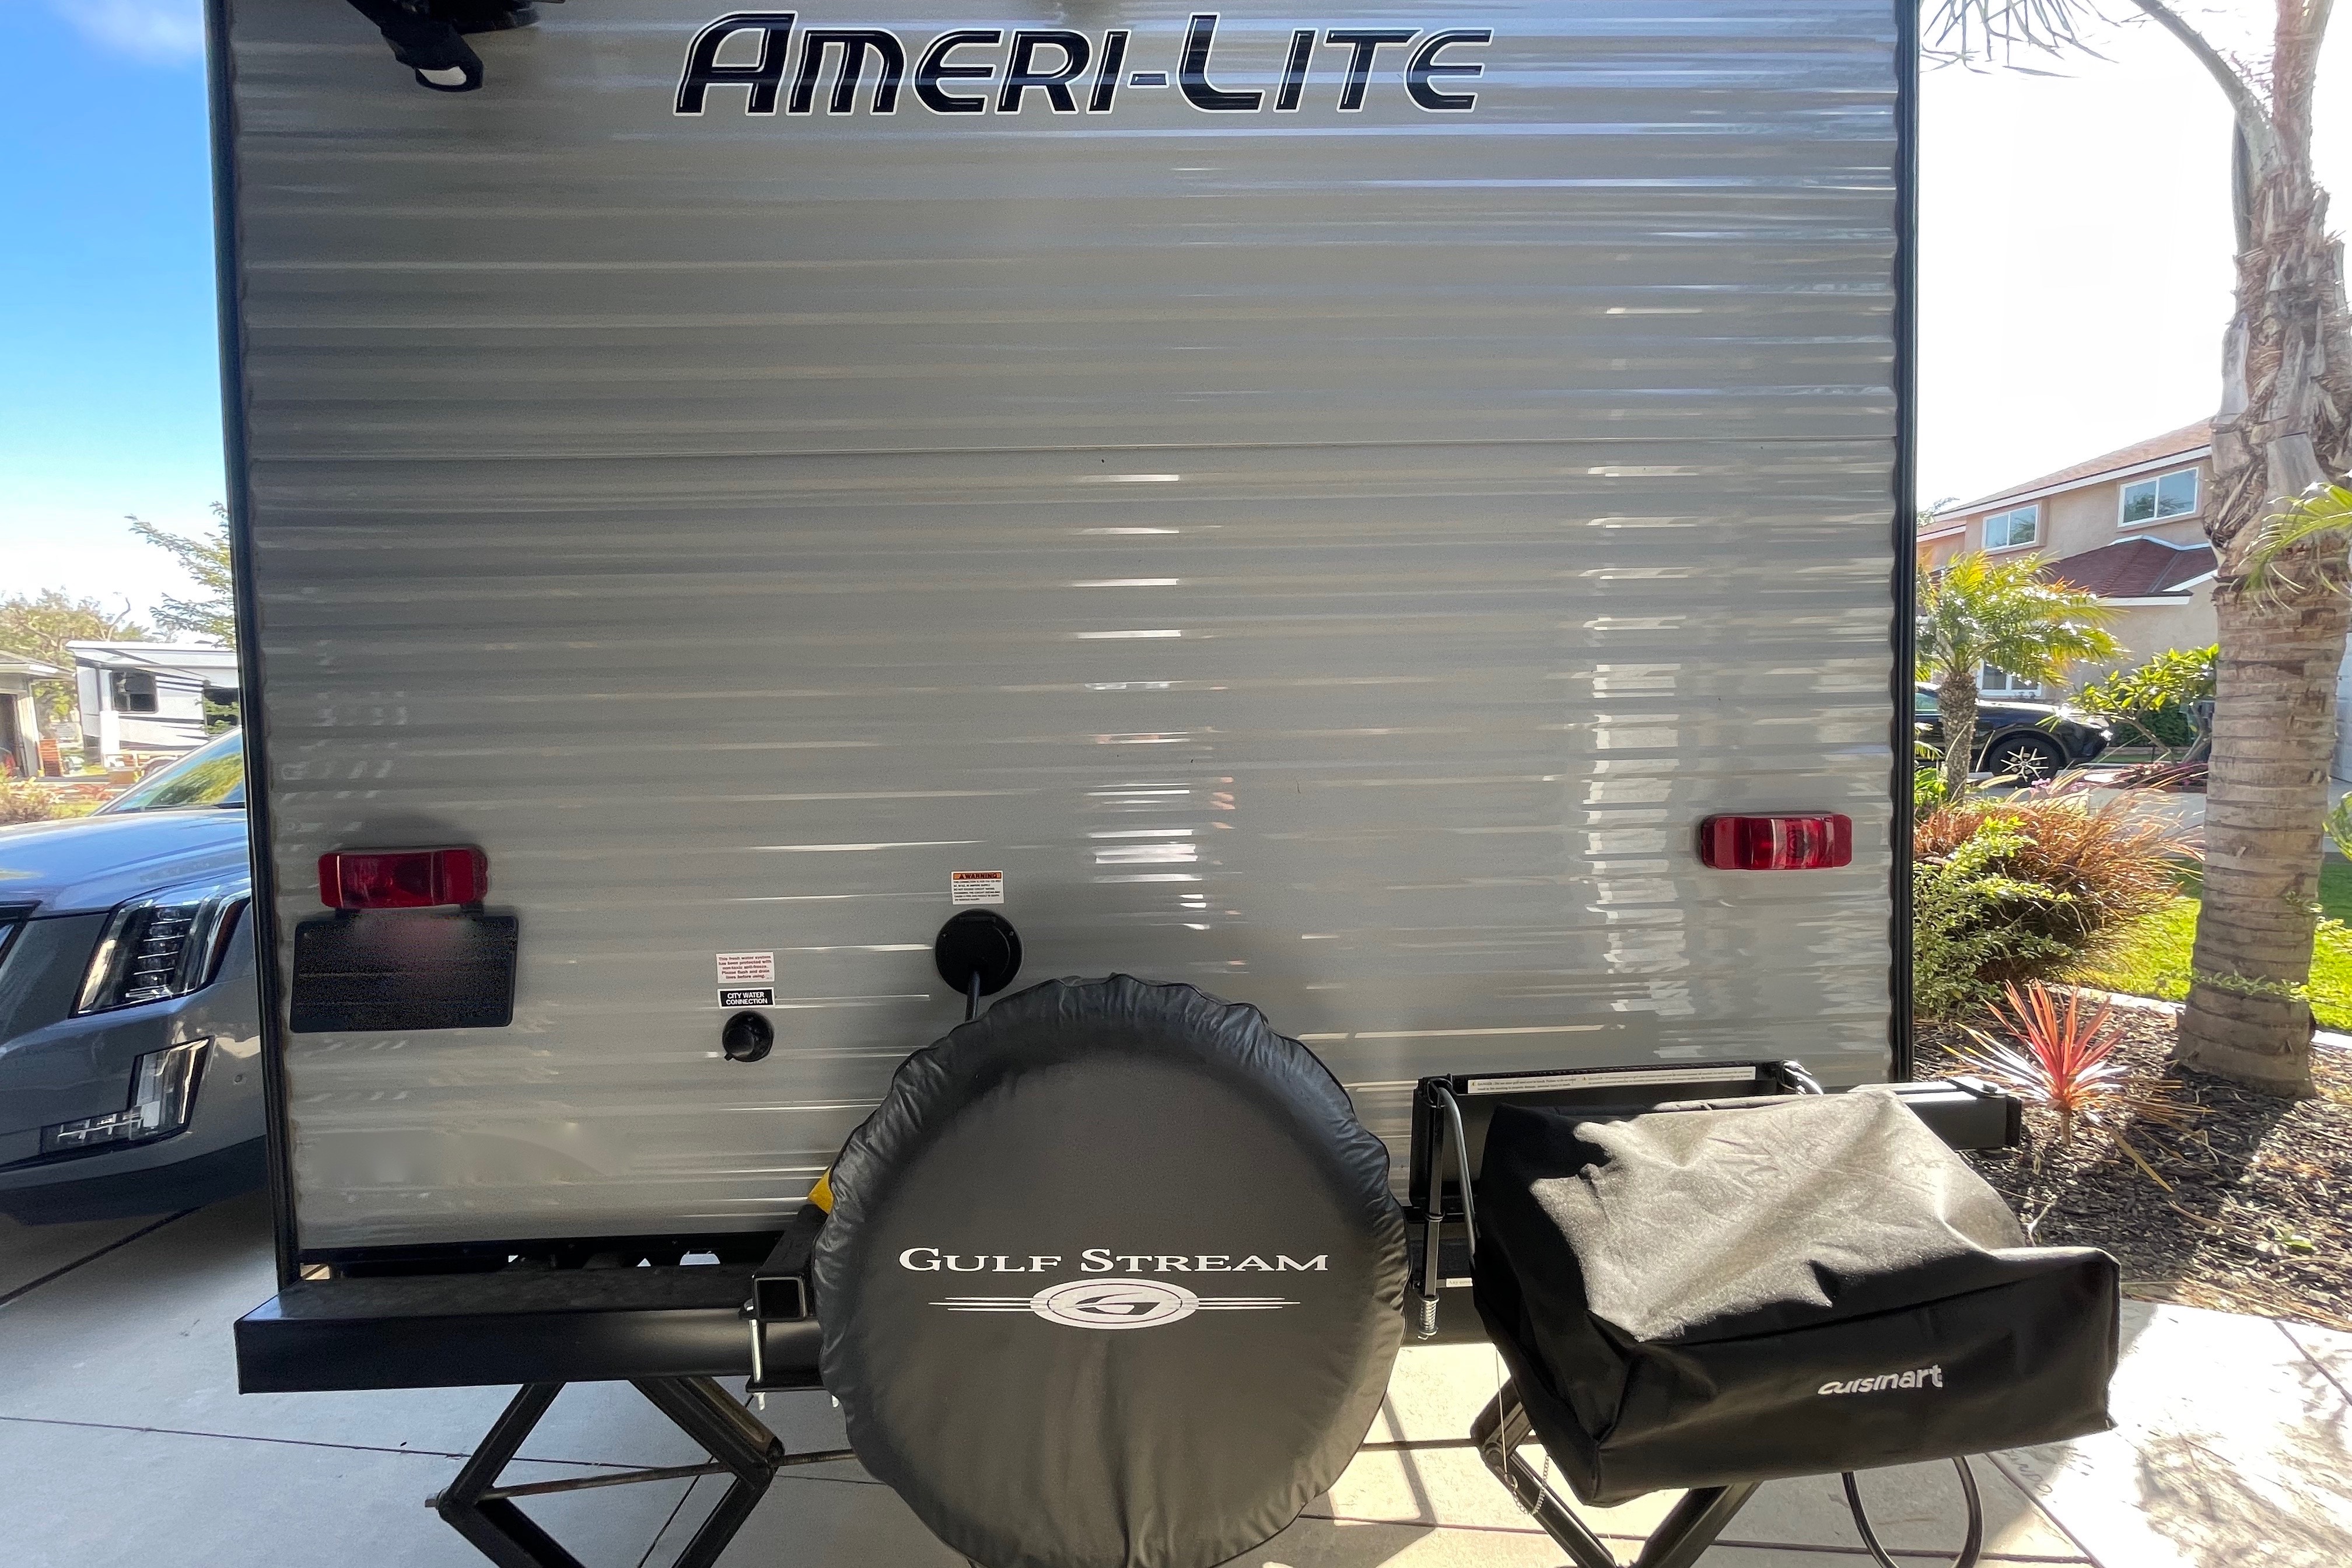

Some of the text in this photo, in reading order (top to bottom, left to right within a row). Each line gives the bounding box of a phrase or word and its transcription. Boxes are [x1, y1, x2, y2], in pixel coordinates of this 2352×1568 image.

[673, 9, 1495, 116] AMERI-LITE
[898, 1247, 1328, 1273] GULF STREAM
